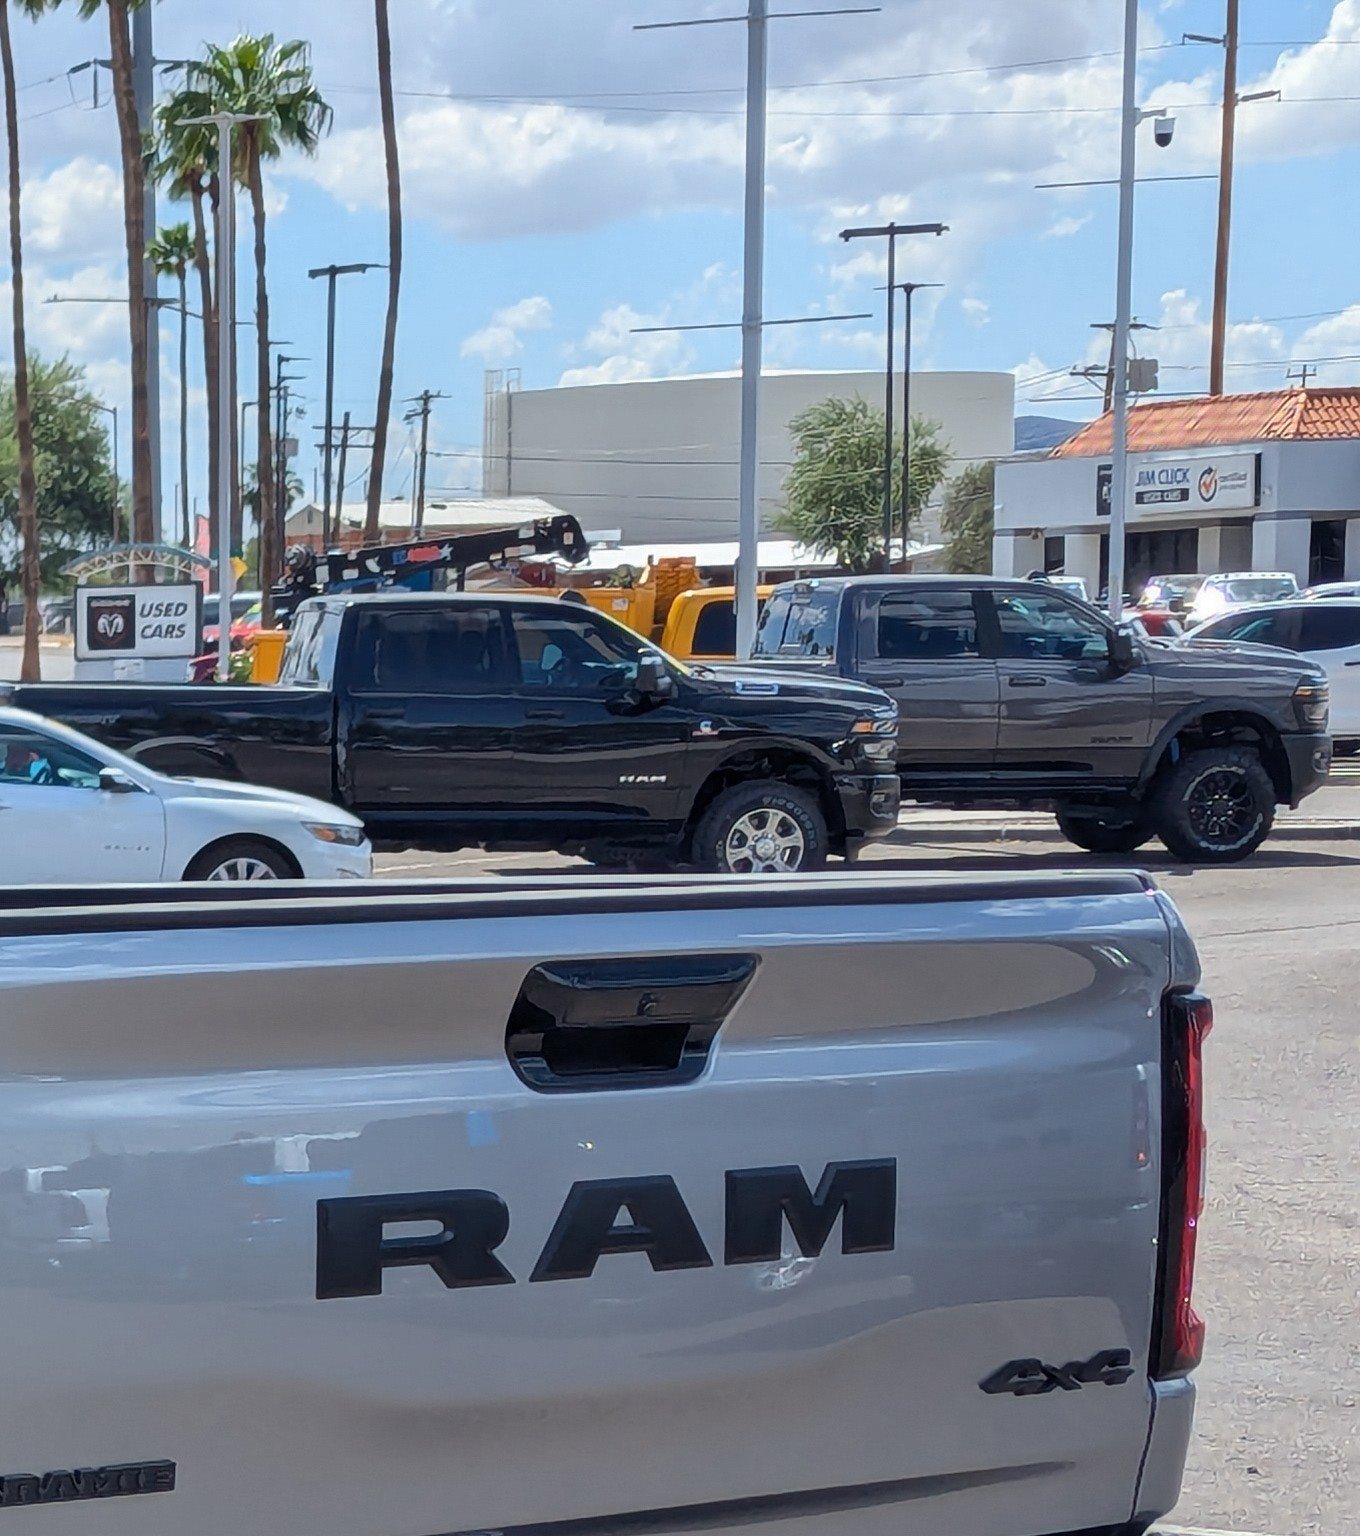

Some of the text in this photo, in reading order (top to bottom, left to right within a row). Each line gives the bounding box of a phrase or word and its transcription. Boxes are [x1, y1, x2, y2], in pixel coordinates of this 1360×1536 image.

[139, 601, 188, 618] USED
[140, 623, 186, 639] CARS
[316, 1156, 898, 1300] RAM
